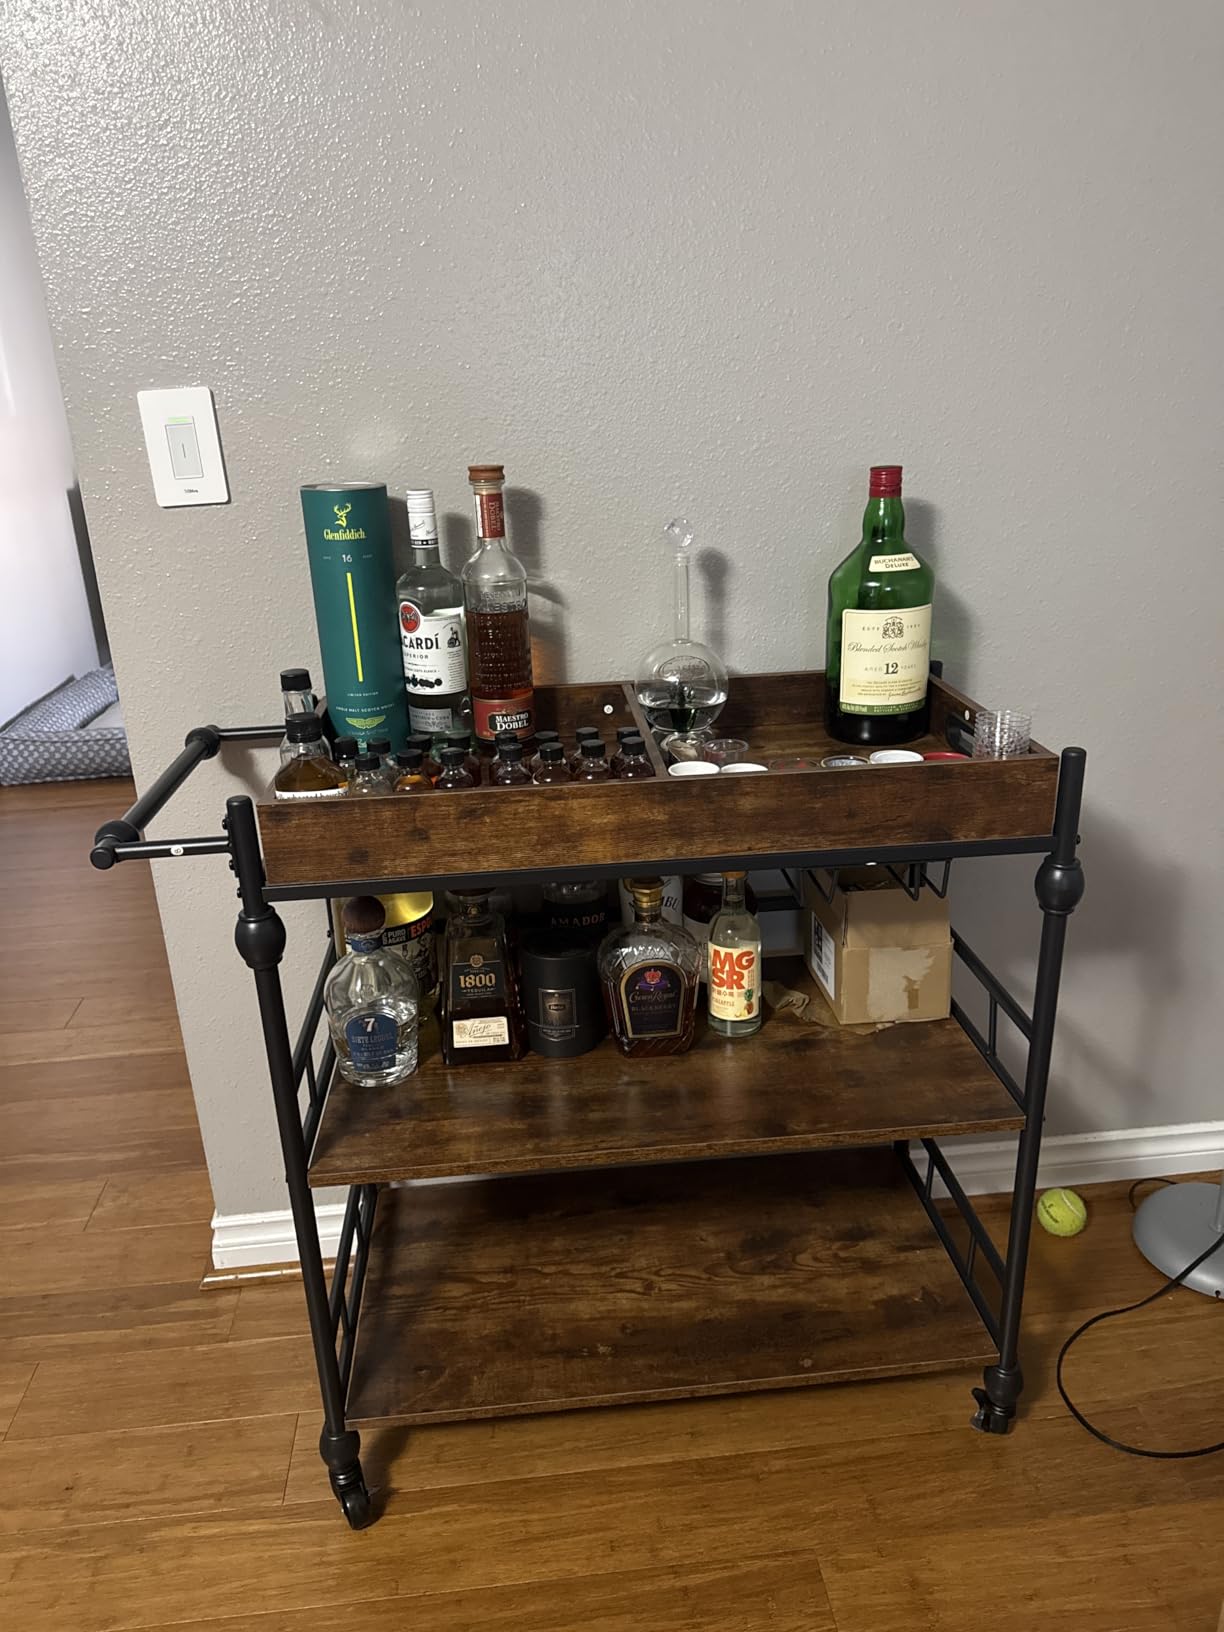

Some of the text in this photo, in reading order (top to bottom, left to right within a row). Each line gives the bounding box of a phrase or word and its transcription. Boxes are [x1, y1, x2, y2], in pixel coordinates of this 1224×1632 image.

[323, 528, 366, 541] Glenfiddich
[341, 554, 353, 563] 16
[402, 633, 438, 650] CARDÍ
[848, 641, 883, 653] Blended
[405, 651, 429, 661] PERIOR
[884, 662, 899, 675] 12
[495, 712, 529, 724] MAESTRO
[496, 720, 529, 731] DOBEL
[551, 912, 606, 929] AMADOR
[712, 949, 755, 970] MG
[458, 973, 496, 988] 1800
[712, 968, 745, 990] SR
[363, 1017, 375, 1033] 7
